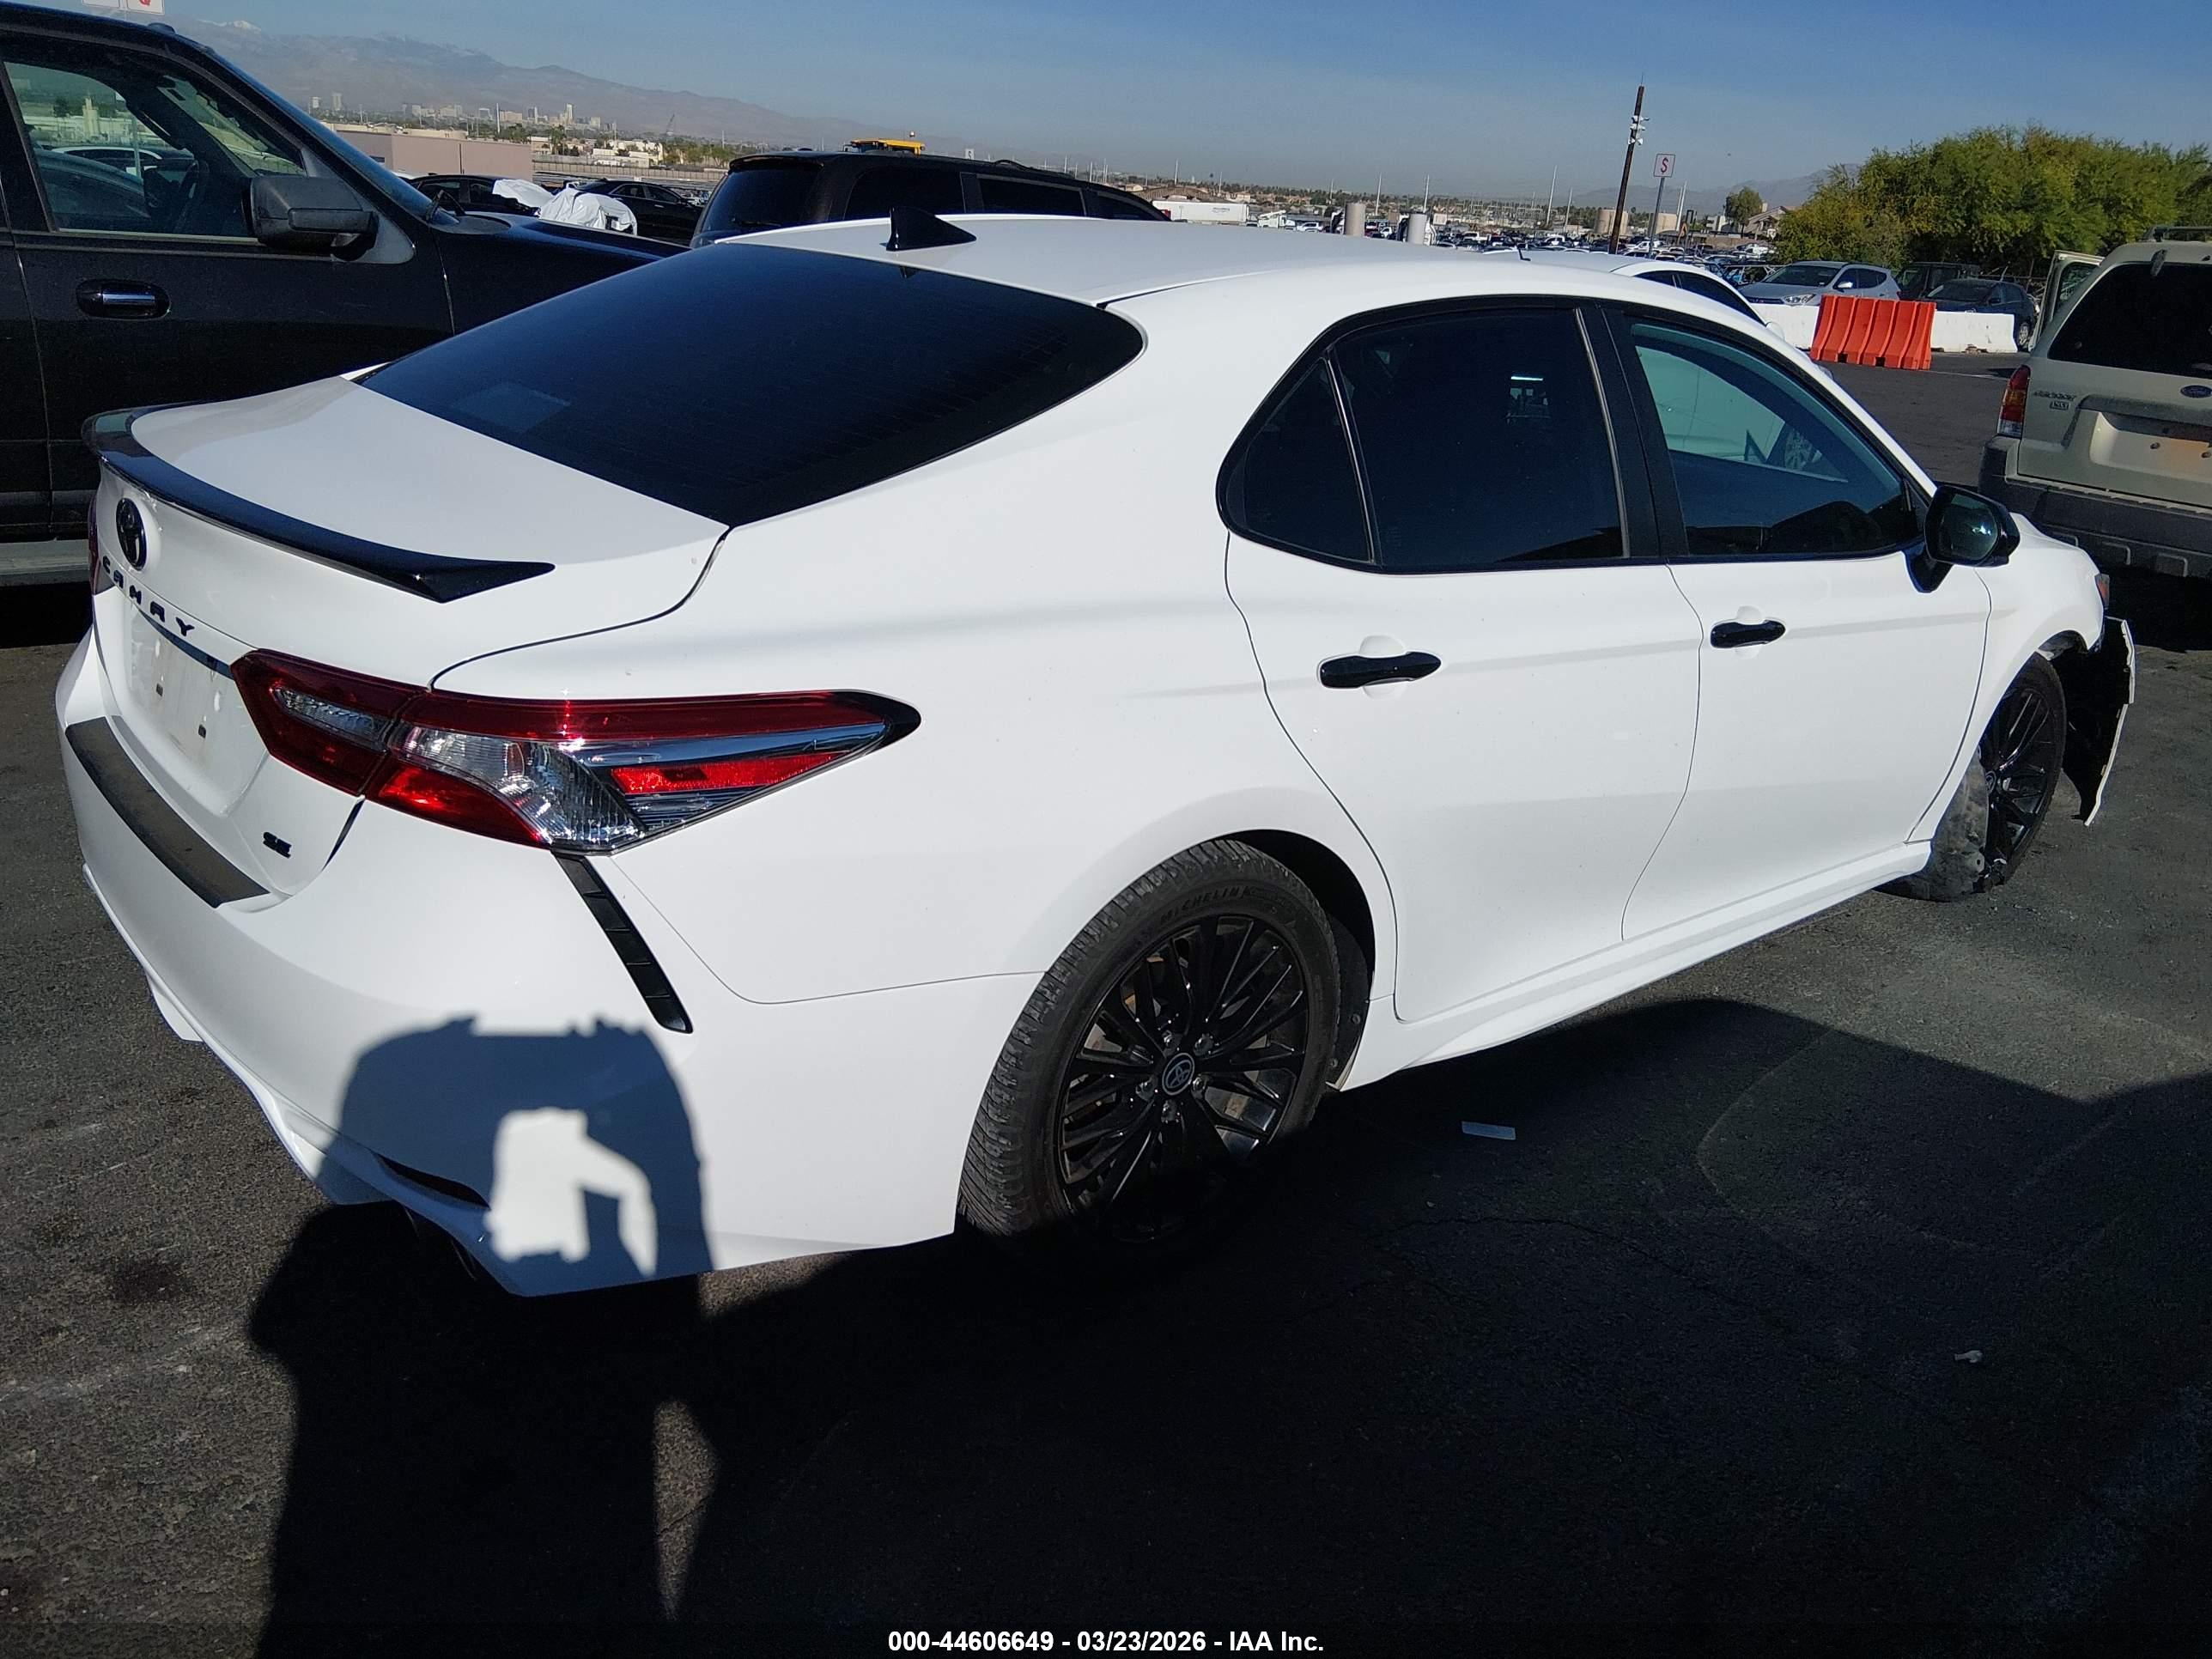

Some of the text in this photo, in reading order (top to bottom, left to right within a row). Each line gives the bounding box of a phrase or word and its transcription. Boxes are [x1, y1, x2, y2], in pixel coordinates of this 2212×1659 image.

[103, 556, 195, 636] CAMRY
[263, 831, 292, 859] SE
[1161, 887, 1240, 922] MICHELIN
